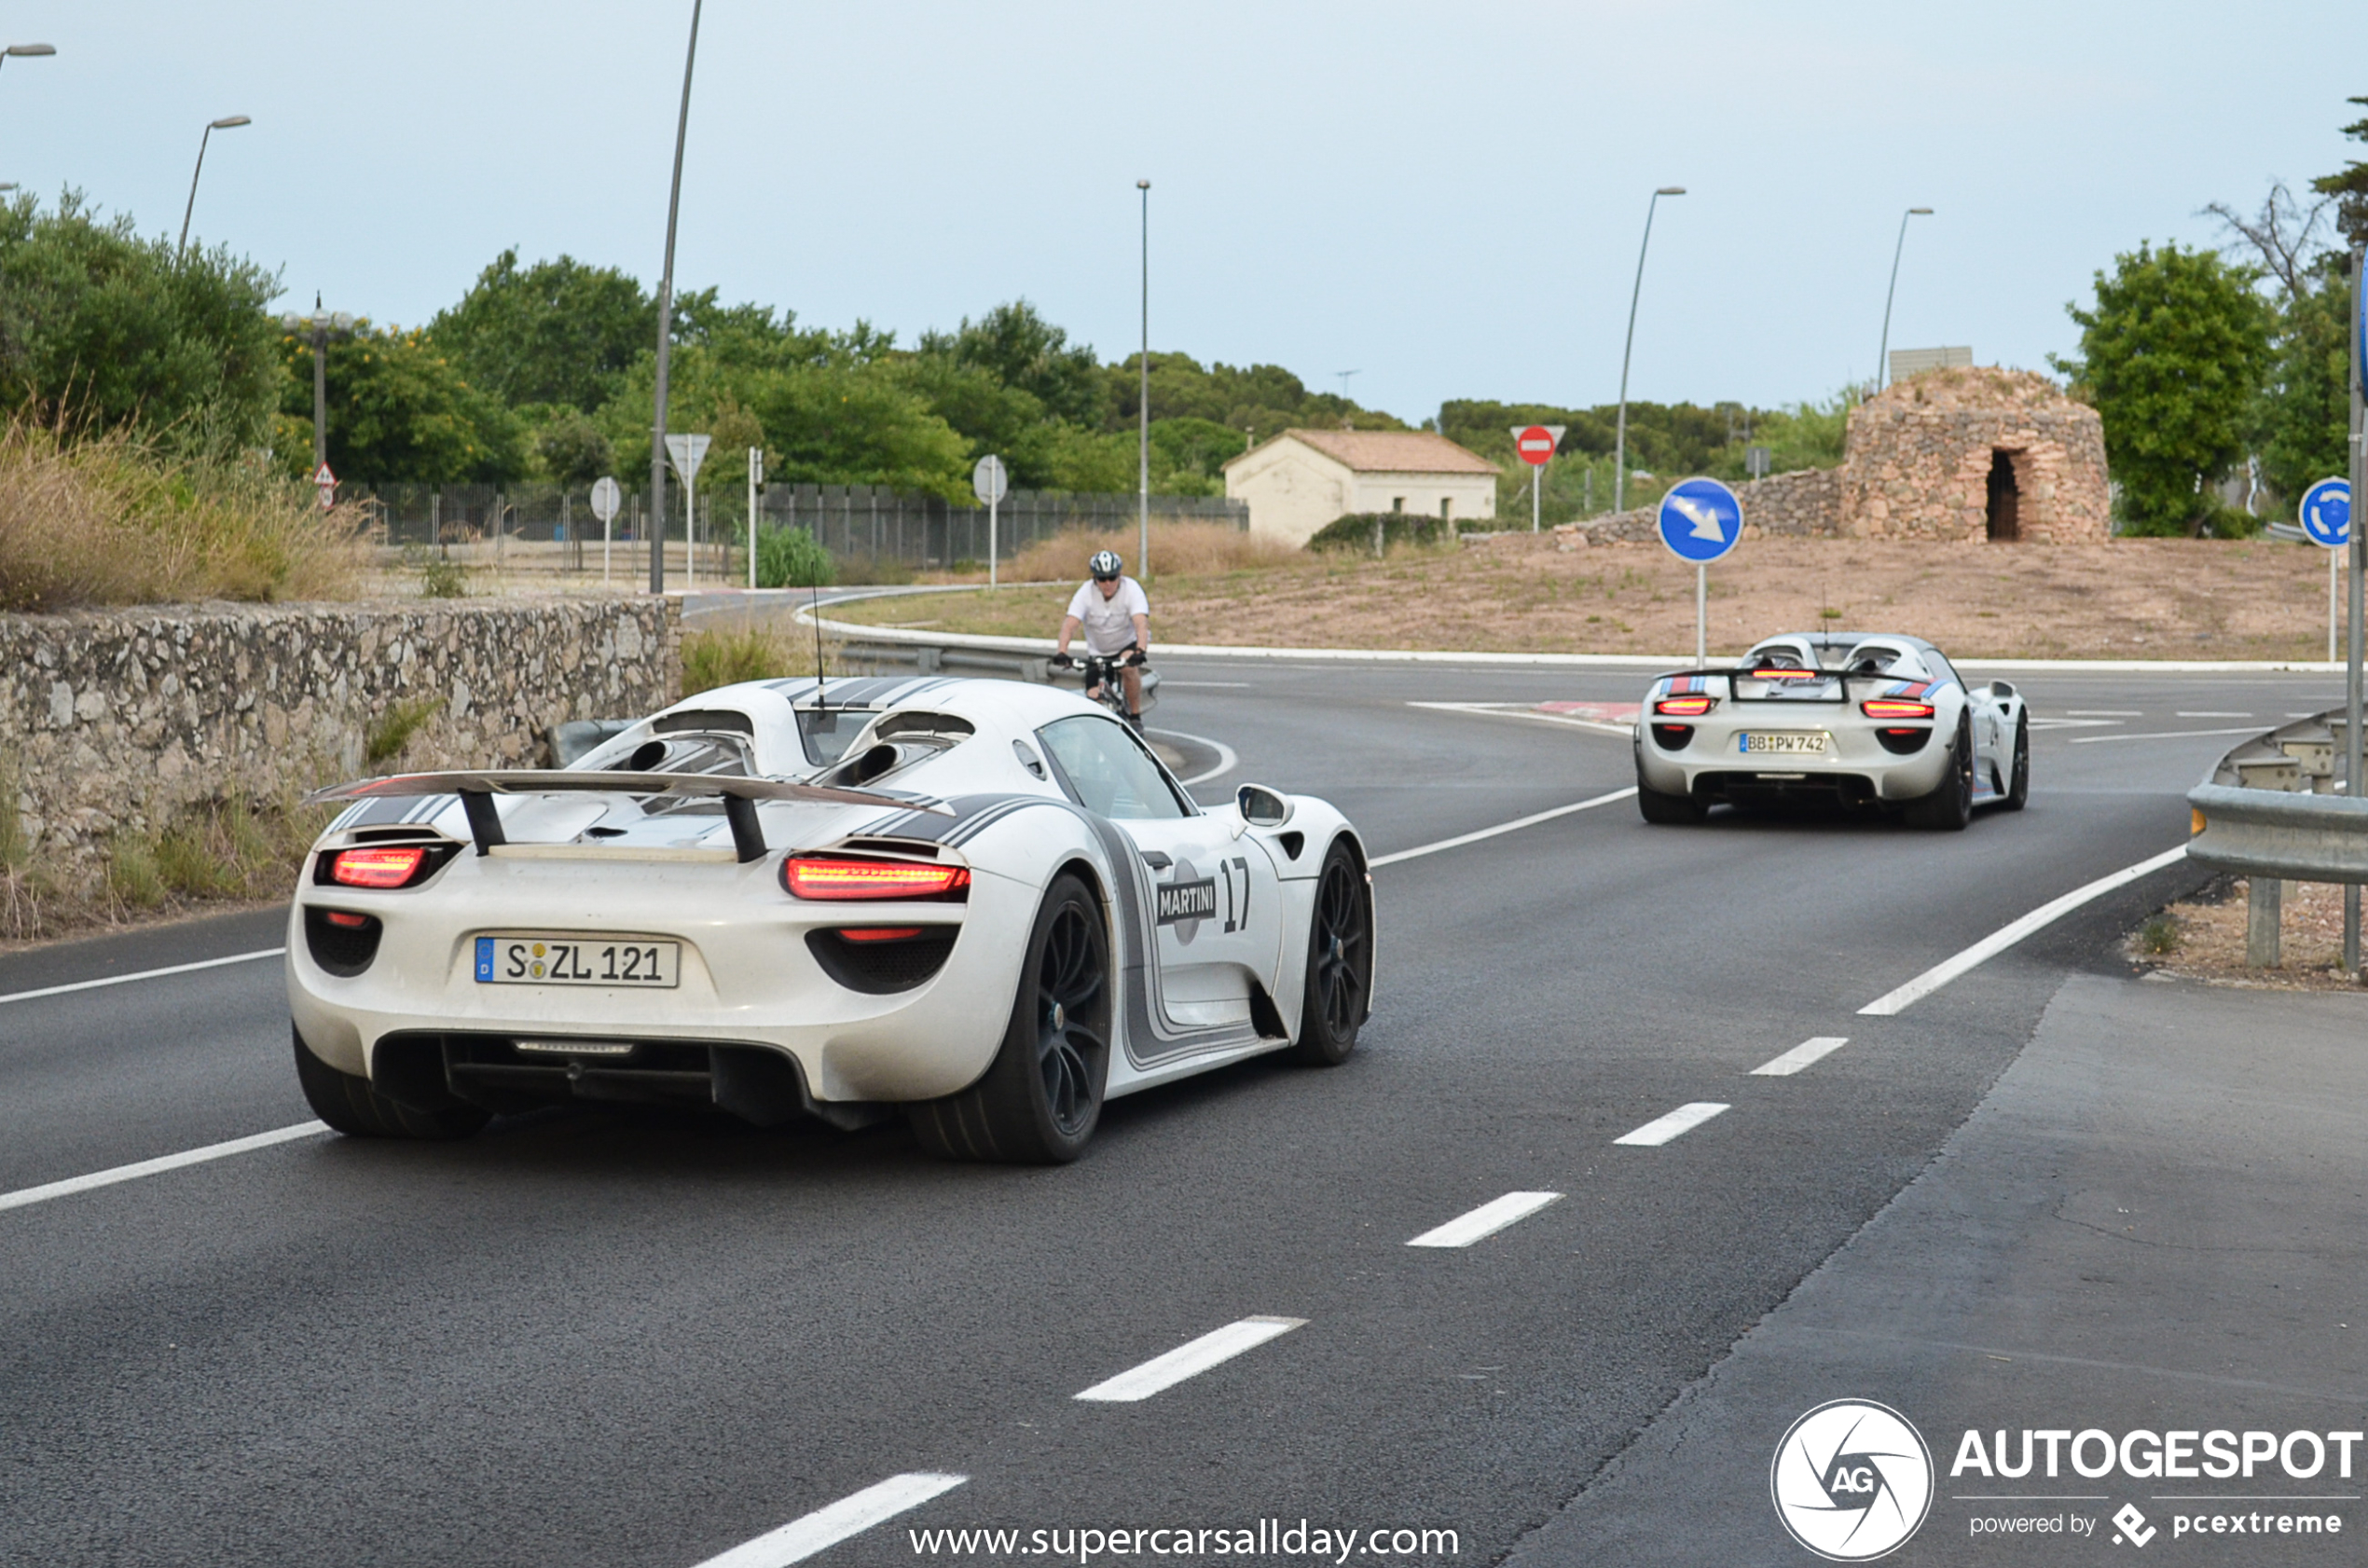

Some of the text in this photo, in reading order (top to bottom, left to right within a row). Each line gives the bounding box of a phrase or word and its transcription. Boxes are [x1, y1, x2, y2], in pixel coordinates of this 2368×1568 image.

[1748, 736, 1824, 751] BB PW 742
[1160, 885, 1214, 917] MARTINI
[1219, 857, 1250, 934] 17
[480, 963, 489, 975] D
[506, 944, 663, 981] S ZL 121
